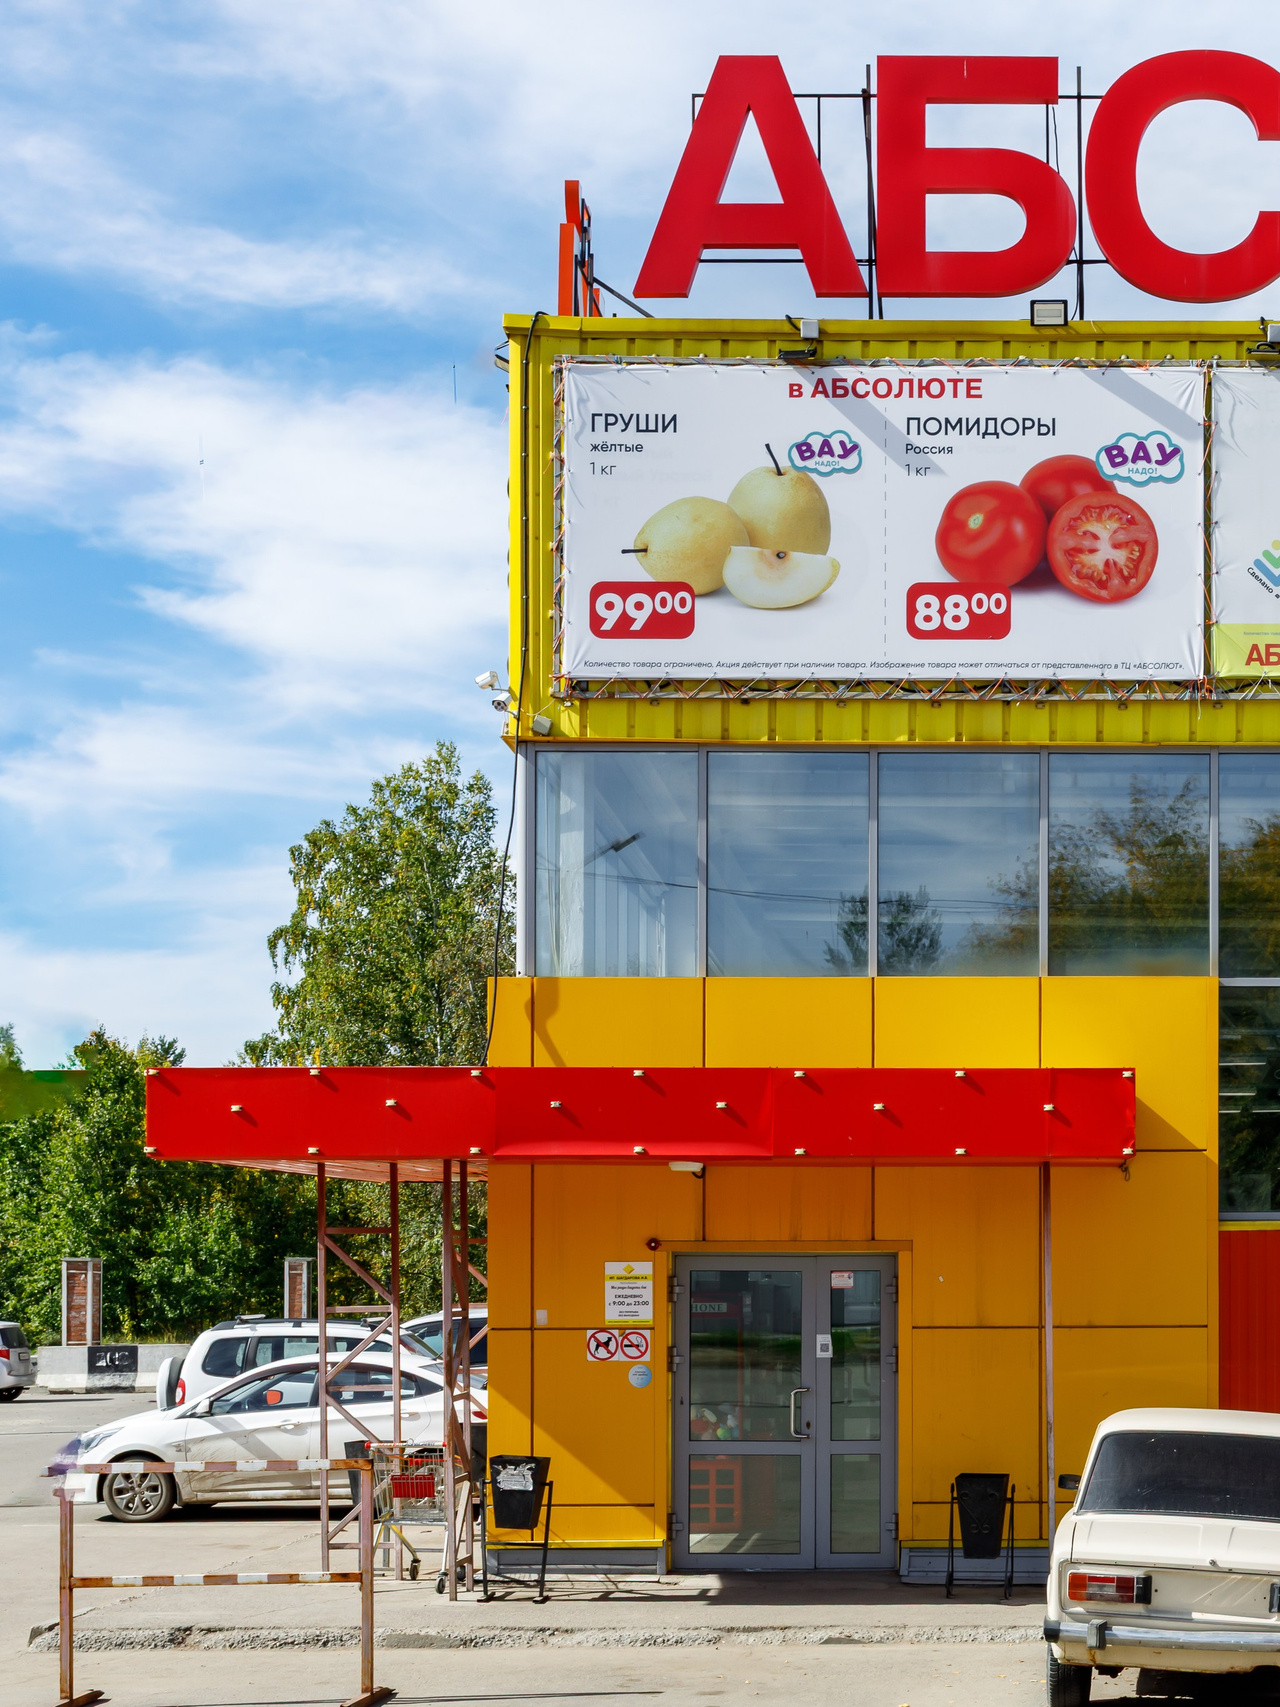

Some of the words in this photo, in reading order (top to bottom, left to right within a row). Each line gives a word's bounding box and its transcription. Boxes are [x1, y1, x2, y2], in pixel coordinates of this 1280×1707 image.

[789, 383, 803, 398] в
[811, 378, 982, 399] АБСОЛЮТЕ
[592, 413, 677, 433] ГРУШИ
[907, 417, 1055, 439] ПОМИДОРЫ
[590, 441, 643, 452] жёлтые
[794, 438, 859, 462] ВАУ
[906, 443, 952, 454] Россия
[1103, 440, 1181, 468] ВАУ
[590, 462, 595, 475] 1
[601, 466, 616, 475] кг
[814, 459, 841, 469] НАДО!
[905, 464, 910, 476] 1
[916, 467, 930, 476] кг
[1127, 465, 1158, 477] НАДО!
[1247, 567, 1273, 593] Сделано
[584, 660, 630, 668] Количество
[632, 661, 662, 669] товара
[664, 661, 713, 669] ограничено.
[716, 661, 740, 669] Акция
[742, 661, 782, 670] действует
[784, 662, 798, 670] при
[837, 662, 868, 670] товара.
[870, 661, 926, 670] Изображение
[985, 662, 1029, 670] отличаться
[1042, 662, 1112, 670] представленного
[1121, 662, 1131, 670] ТЦ
[1133, 662, 1184, 670] «АБСОЛЮТ».
